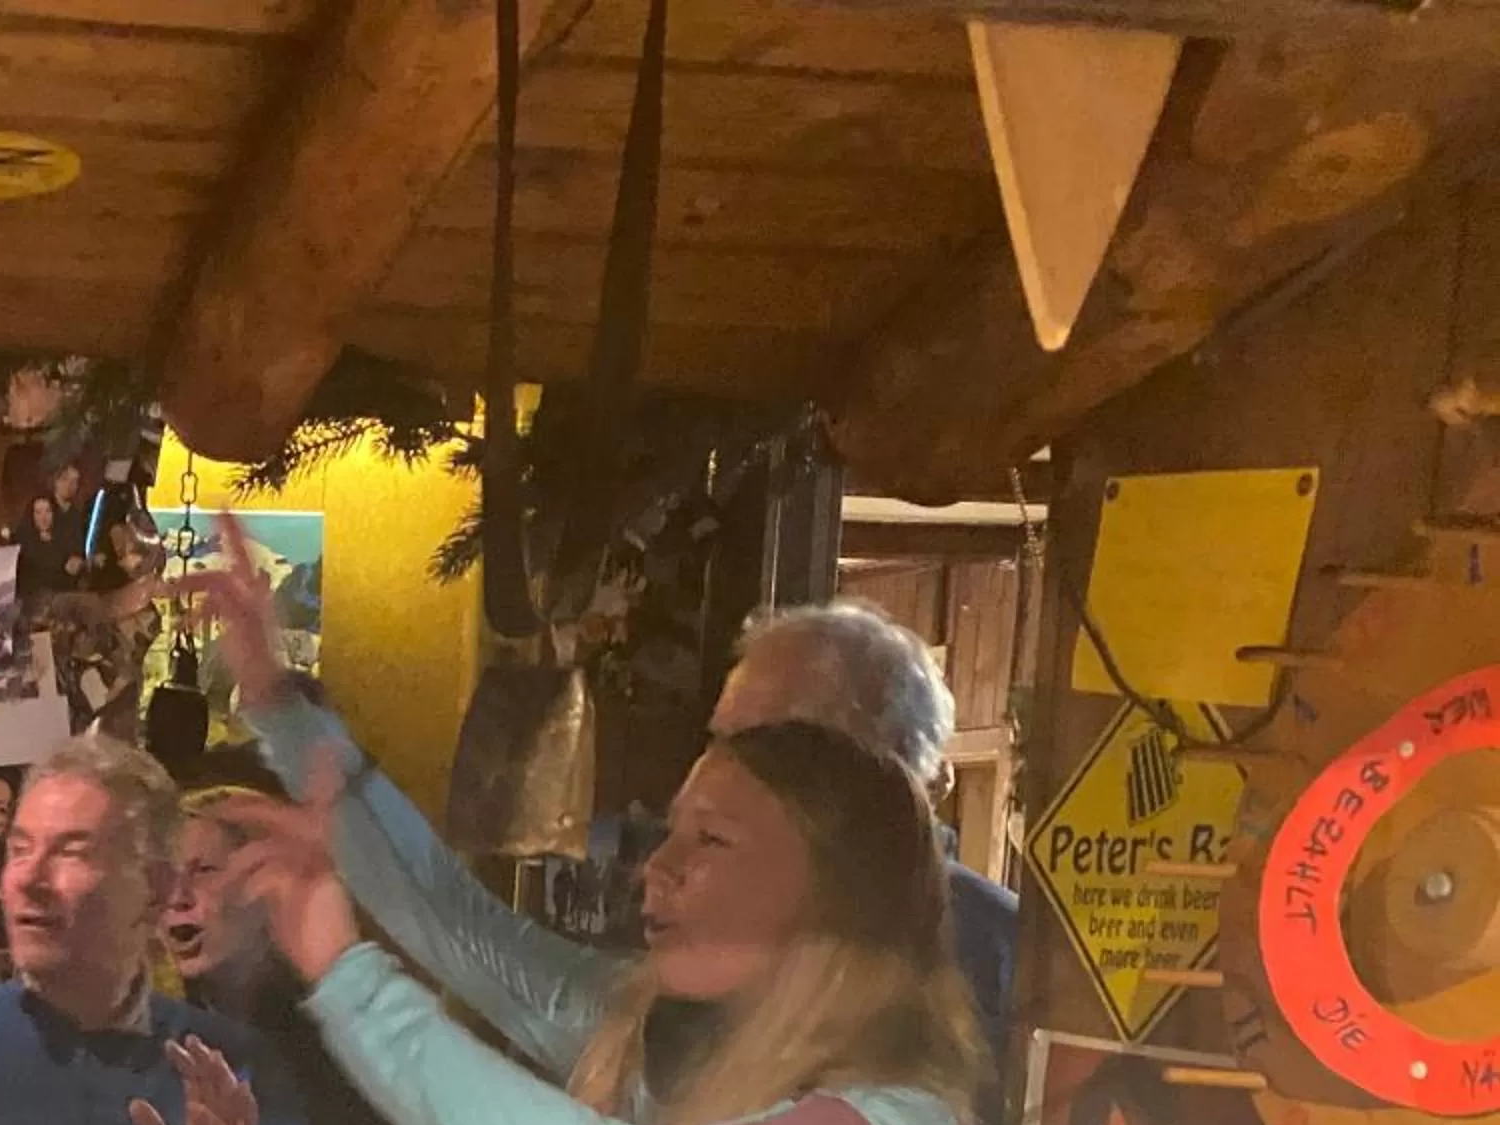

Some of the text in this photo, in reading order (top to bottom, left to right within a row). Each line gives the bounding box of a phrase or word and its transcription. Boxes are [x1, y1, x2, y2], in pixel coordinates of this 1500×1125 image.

[1050, 824, 1173, 876] Peter's
[1284, 760, 1390, 935] BEZAHLT
[1072, 880, 1221, 910] here we drink beer
[1088, 911, 1199, 942] beer and even
[1099, 948, 1141, 969] more
[1313, 995, 1372, 1051] DIE
